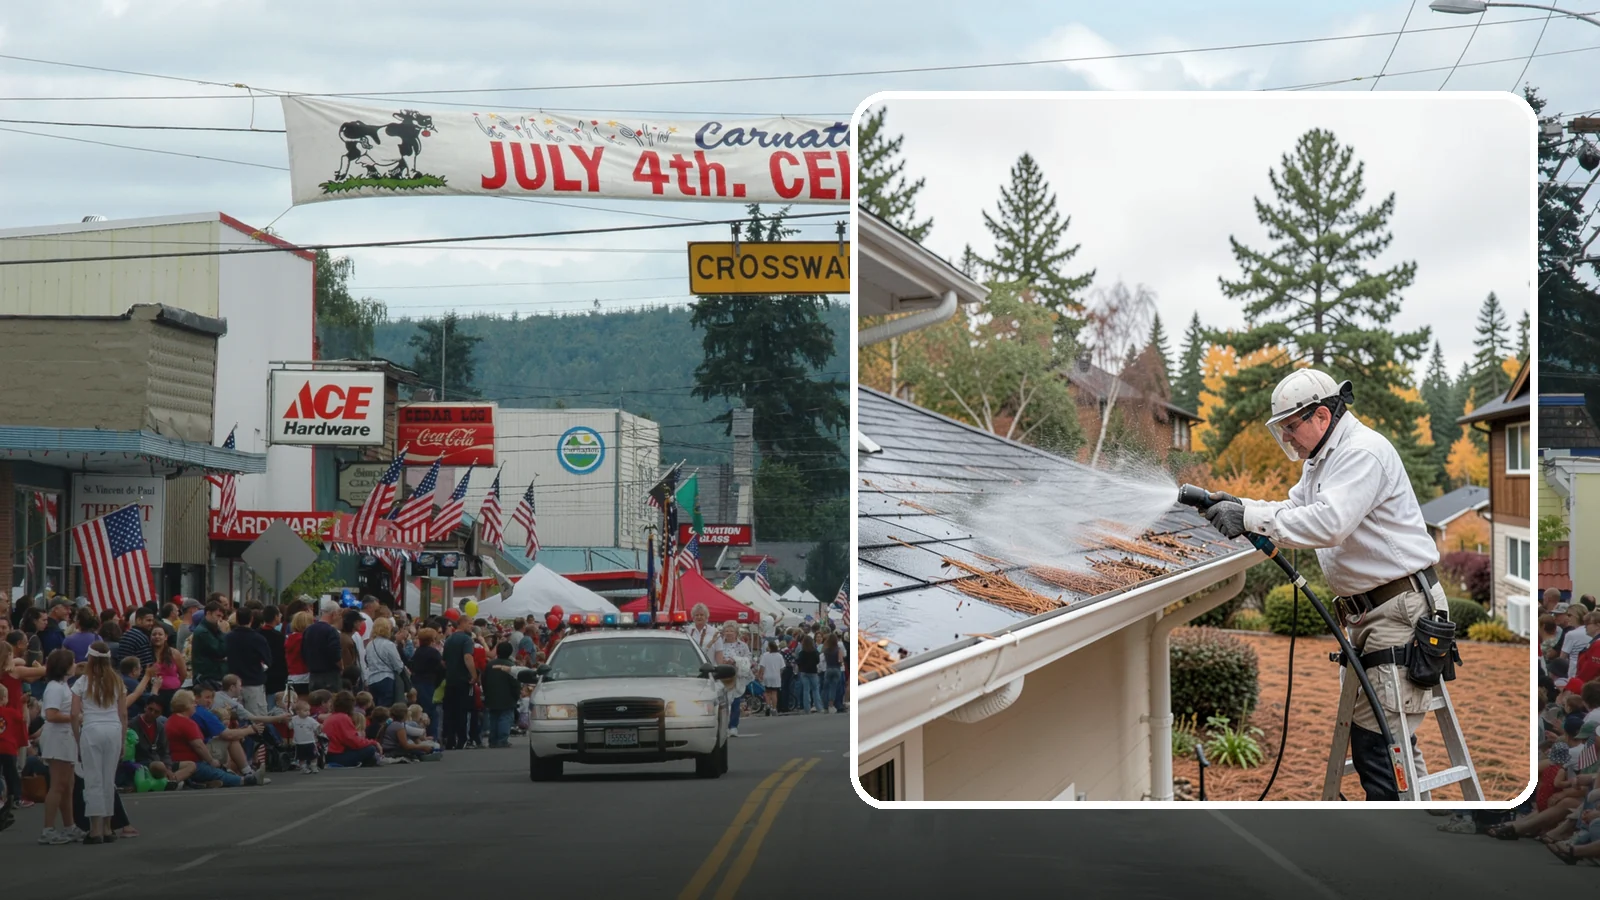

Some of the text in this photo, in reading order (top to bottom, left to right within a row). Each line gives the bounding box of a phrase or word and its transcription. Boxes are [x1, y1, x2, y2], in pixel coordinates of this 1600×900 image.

[695, 121, 850, 149] Carnat
[481, 141, 604, 192] JULY
[632, 150, 746, 198] 4th.
[697, 254, 850, 280] CROSSWA
[282, 380, 373, 420] ACE
[405, 409, 452, 422] CEDAR
[283, 421, 371, 436] Hardware
[83, 485, 155, 495] St. Vincent de Paul
[688, 526, 742, 535] CRNATION
[699, 535, 730, 543] GLASS
